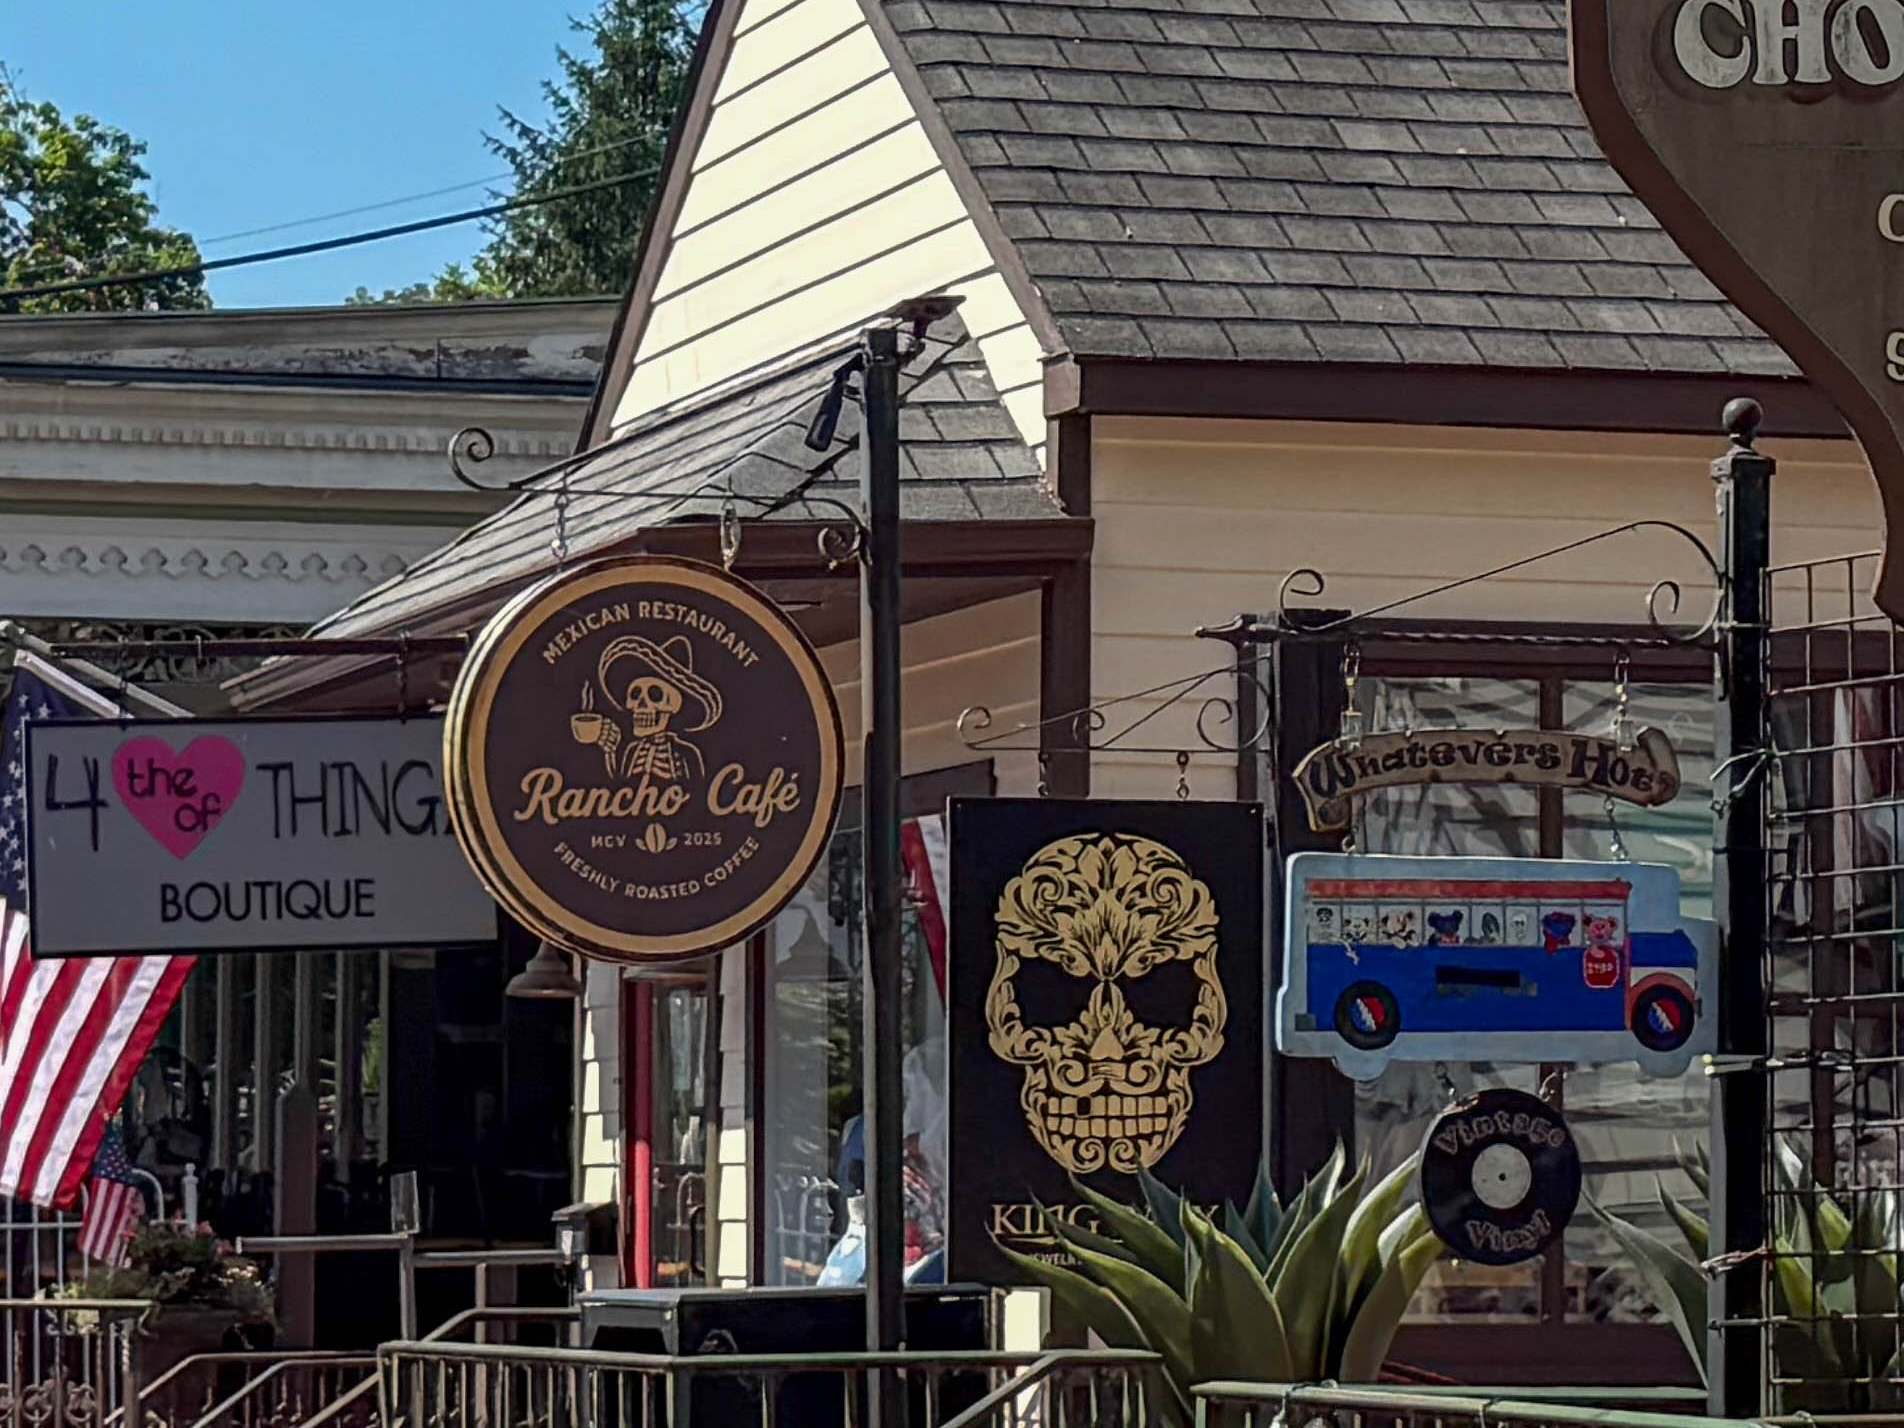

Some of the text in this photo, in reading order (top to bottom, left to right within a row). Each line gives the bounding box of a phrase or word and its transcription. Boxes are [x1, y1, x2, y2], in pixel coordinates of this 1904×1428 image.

[542, 600, 760, 668] MEXICAN RESTAURANT
[45, 752, 457, 853] 4 the of THING
[513, 762, 802, 829] Rancho Café
[160, 877, 376, 924] BOUTIQUE
[553, 836, 761, 901] FRESHLY ROASTED COFFEE
